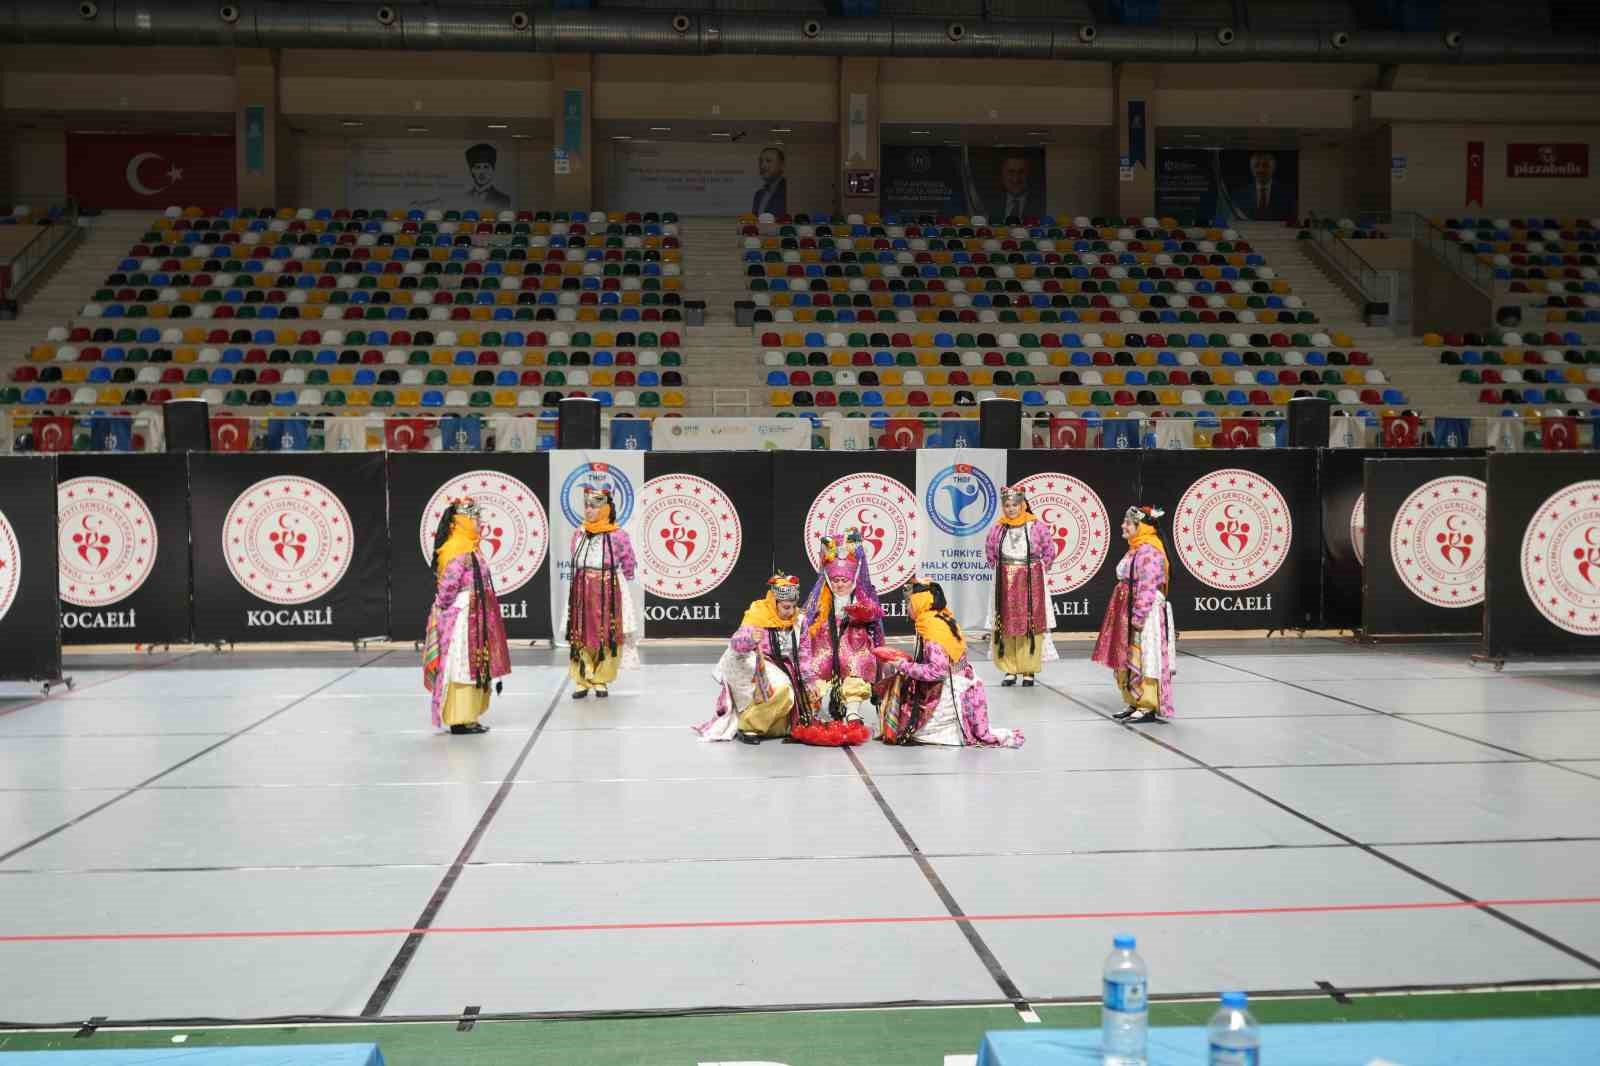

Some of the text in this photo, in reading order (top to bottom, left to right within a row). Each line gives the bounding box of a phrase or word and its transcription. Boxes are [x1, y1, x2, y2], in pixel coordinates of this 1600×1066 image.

[941, 549, 982, 558] TÜRKİYE
[922, 561, 992, 569] HALK OYUNLA
[1052, 598, 1089, 615] AELİ
[1195, 593, 1272, 611] KOCAELİ
[247, 606, 333, 626] KOCAELİ
